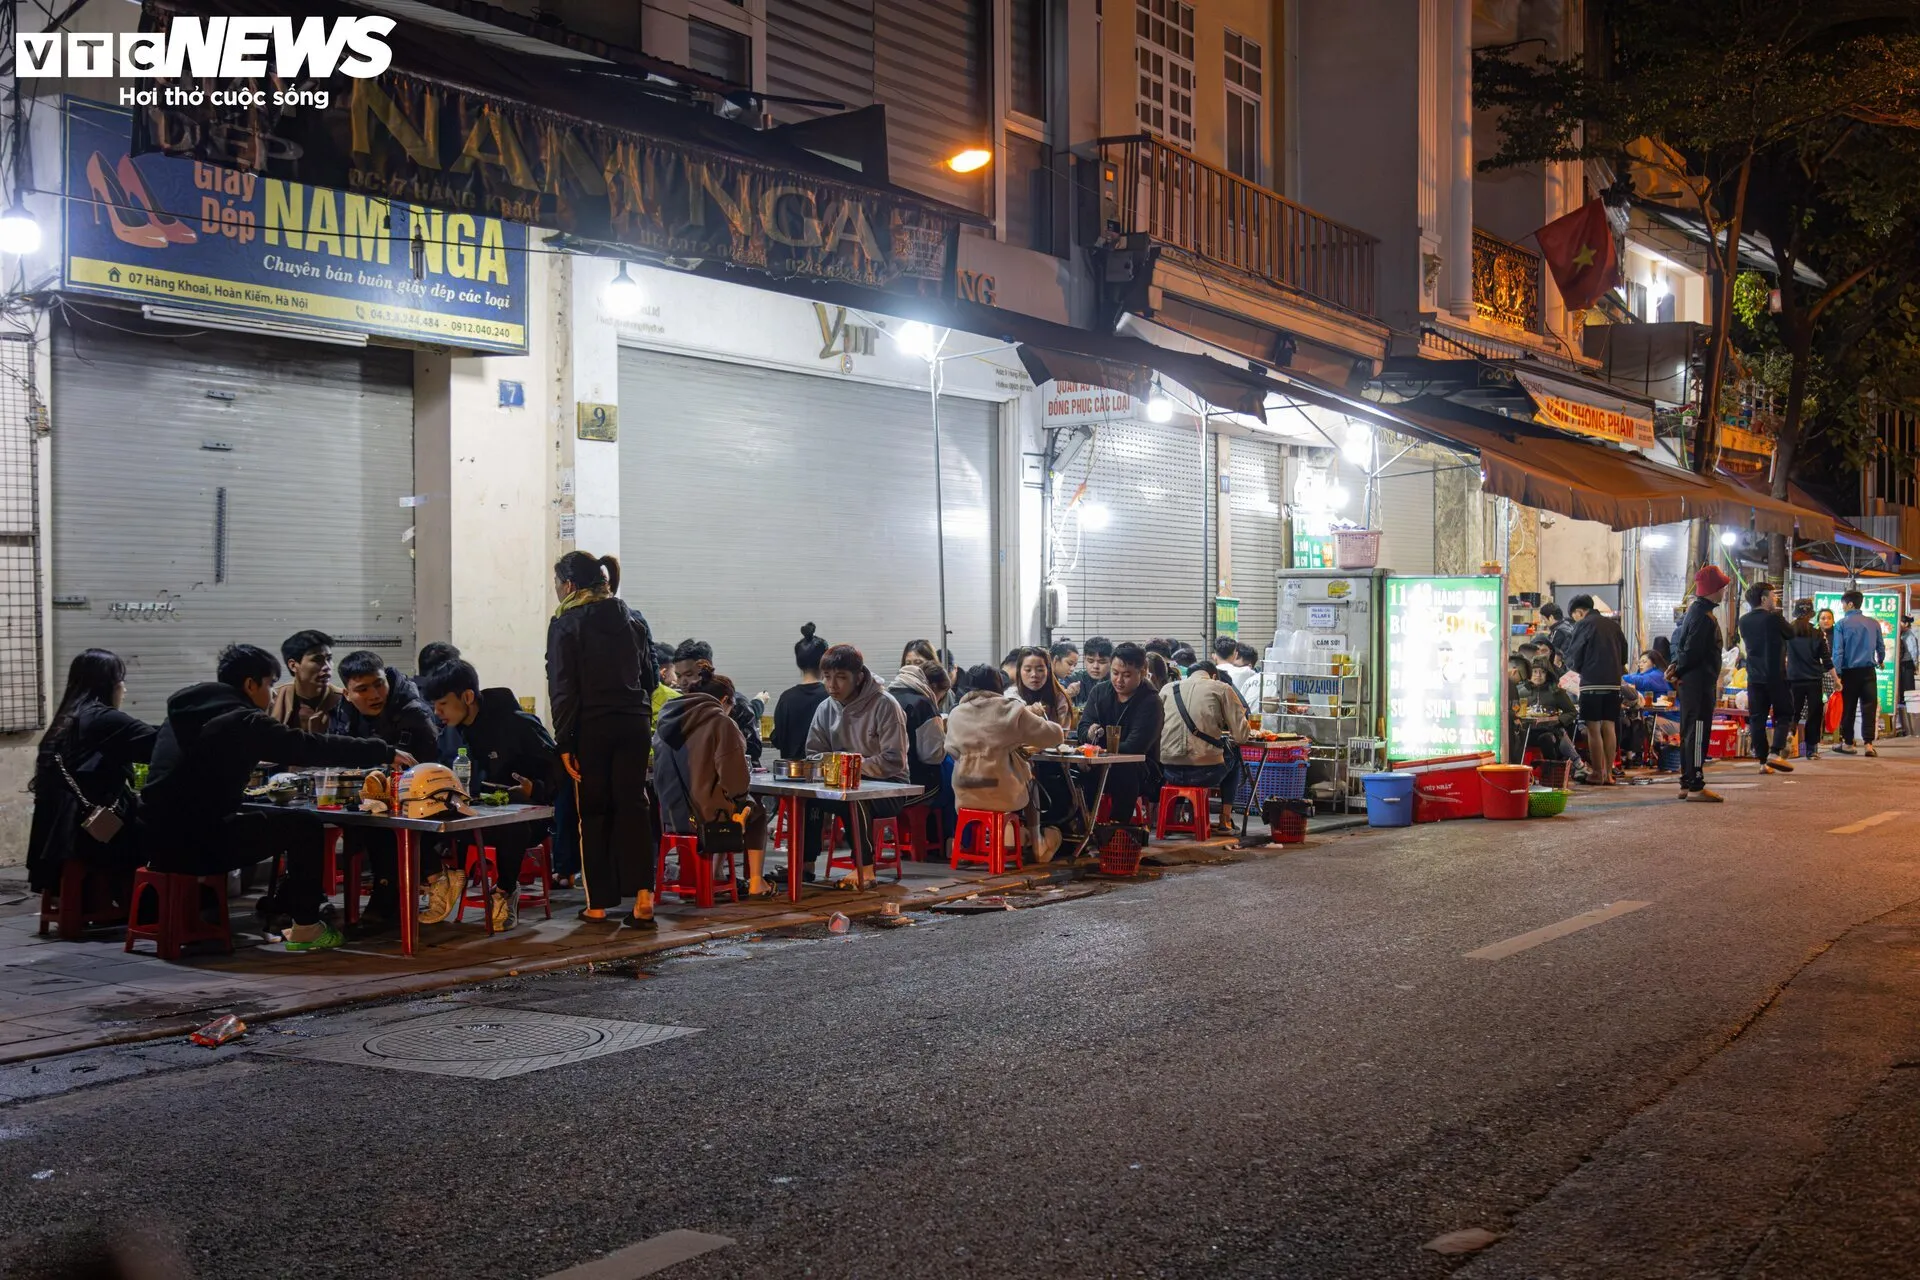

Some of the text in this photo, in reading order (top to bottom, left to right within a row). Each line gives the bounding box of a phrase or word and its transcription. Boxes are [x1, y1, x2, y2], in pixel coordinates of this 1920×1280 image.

[202, 196, 256, 244] Dép
[264, 177, 509, 286] NAM NGA
[129, 272, 309, 311] 07 Hàng Khoai, Hoàn Kiếm, Hà Nội
[263, 254, 320, 279] Chuyên
[325, 264, 353, 283] bán
[358, 270, 394, 289] buôn
[431, 283, 455, 302] dép
[459, 288, 481, 304] các
[485, 291, 511, 310] loại
[451, 320, 511, 339] 0912.040.240
[506, 386, 517, 403] 7
[1071, 397, 1092, 416] PHỤC
[1094, 393, 1110, 412] CÁC
[1112, 395, 1130, 413] LOẠI
[593, 407, 606, 428] 9
